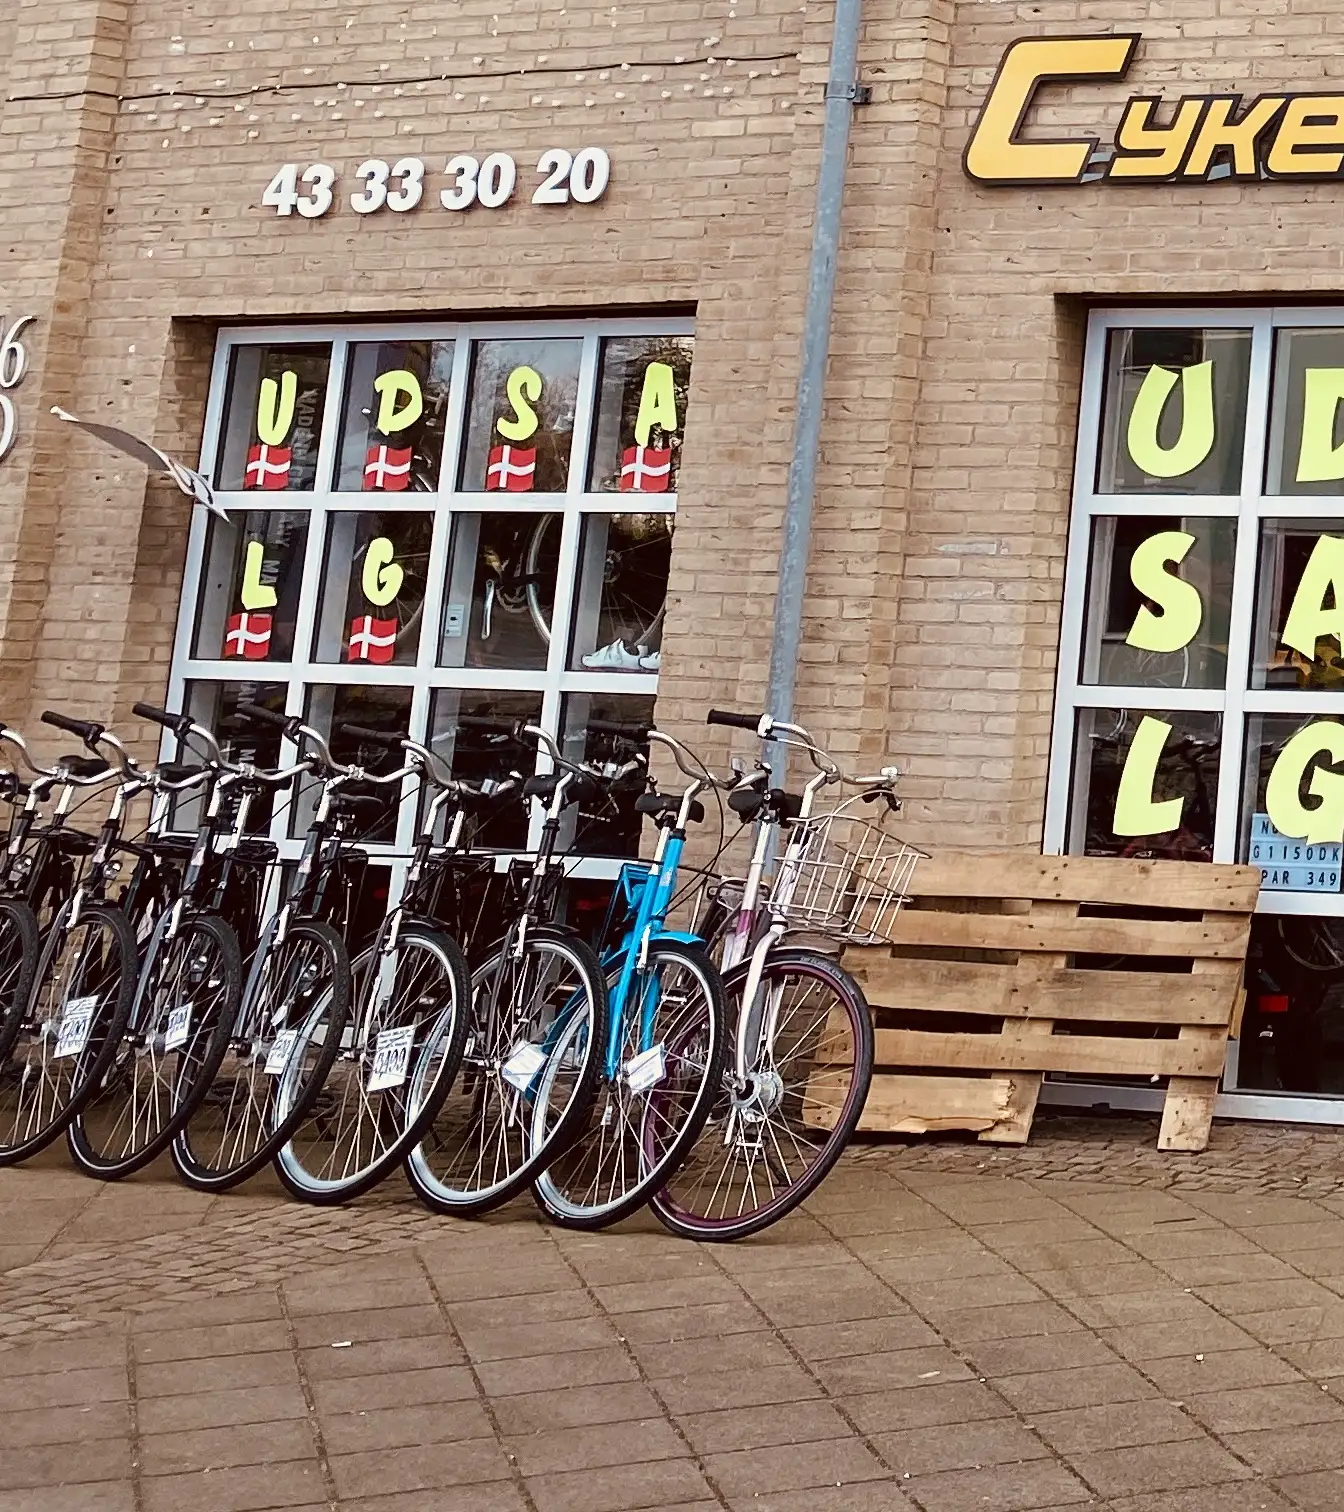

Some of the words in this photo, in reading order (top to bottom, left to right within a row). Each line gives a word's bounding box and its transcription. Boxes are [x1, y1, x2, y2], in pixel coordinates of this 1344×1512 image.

[262, 163, 336, 218] 43
[350, 157, 425, 213] 33
[440, 153, 517, 210] 30
[531, 147, 610, 204] 20
[1127, 359, 1215, 478] U
[1125, 530, 1203, 653] S
[1112, 715, 1185, 837] L
[1260, 869, 1290, 885] PAR
[1307, 871, 1337, 886] 349
